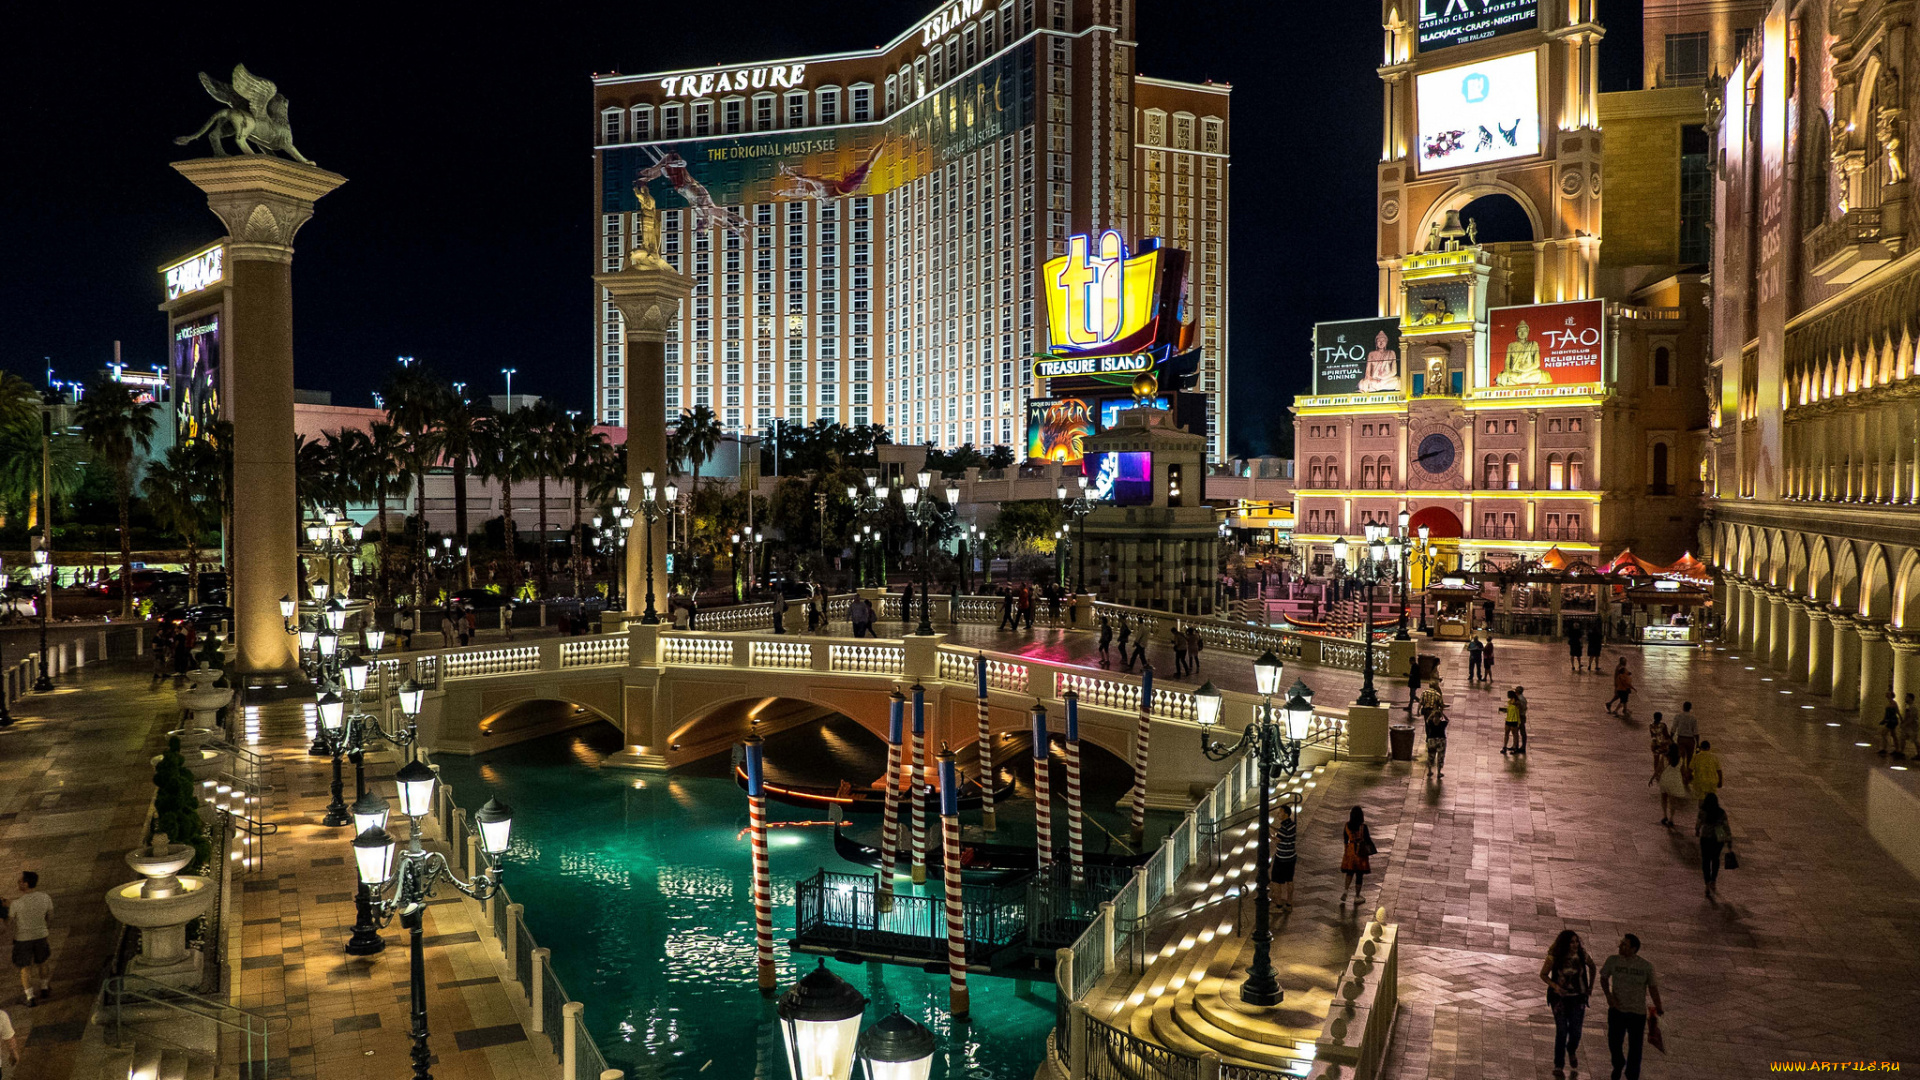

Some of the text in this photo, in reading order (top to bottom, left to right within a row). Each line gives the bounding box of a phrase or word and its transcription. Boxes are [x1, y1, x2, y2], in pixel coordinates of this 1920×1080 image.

[1418, 17, 1449, 29] CASINO
[1452, 11, 1475, 22] CLUB
[1482, 0, 1516, 14] SPORTS
[1419, 0, 1490, 21] LA
[922, 0, 983, 47] ISLAND
[1420, 9, 1536, 42] BLACKJACK CRAPS NIGHTLIFE
[1457, 30, 1495, 44] THE PALAZZO
[660, 64, 806, 97] TREASURE
[708, 138, 836, 161] THE ORIGINAL MUST-SEE
[1763, 187, 1781, 225] CAKE
[1762, 223, 1780, 263] BOSS
[1541, 327, 1599, 349] TAO
[1319, 345, 1365, 363] TAO
[1544, 354, 1598, 363] RELIGIOUS
[1545, 360, 1597, 368] NIGHTLIFE
[1040, 355, 1145, 376] TREASURE ISLAND
